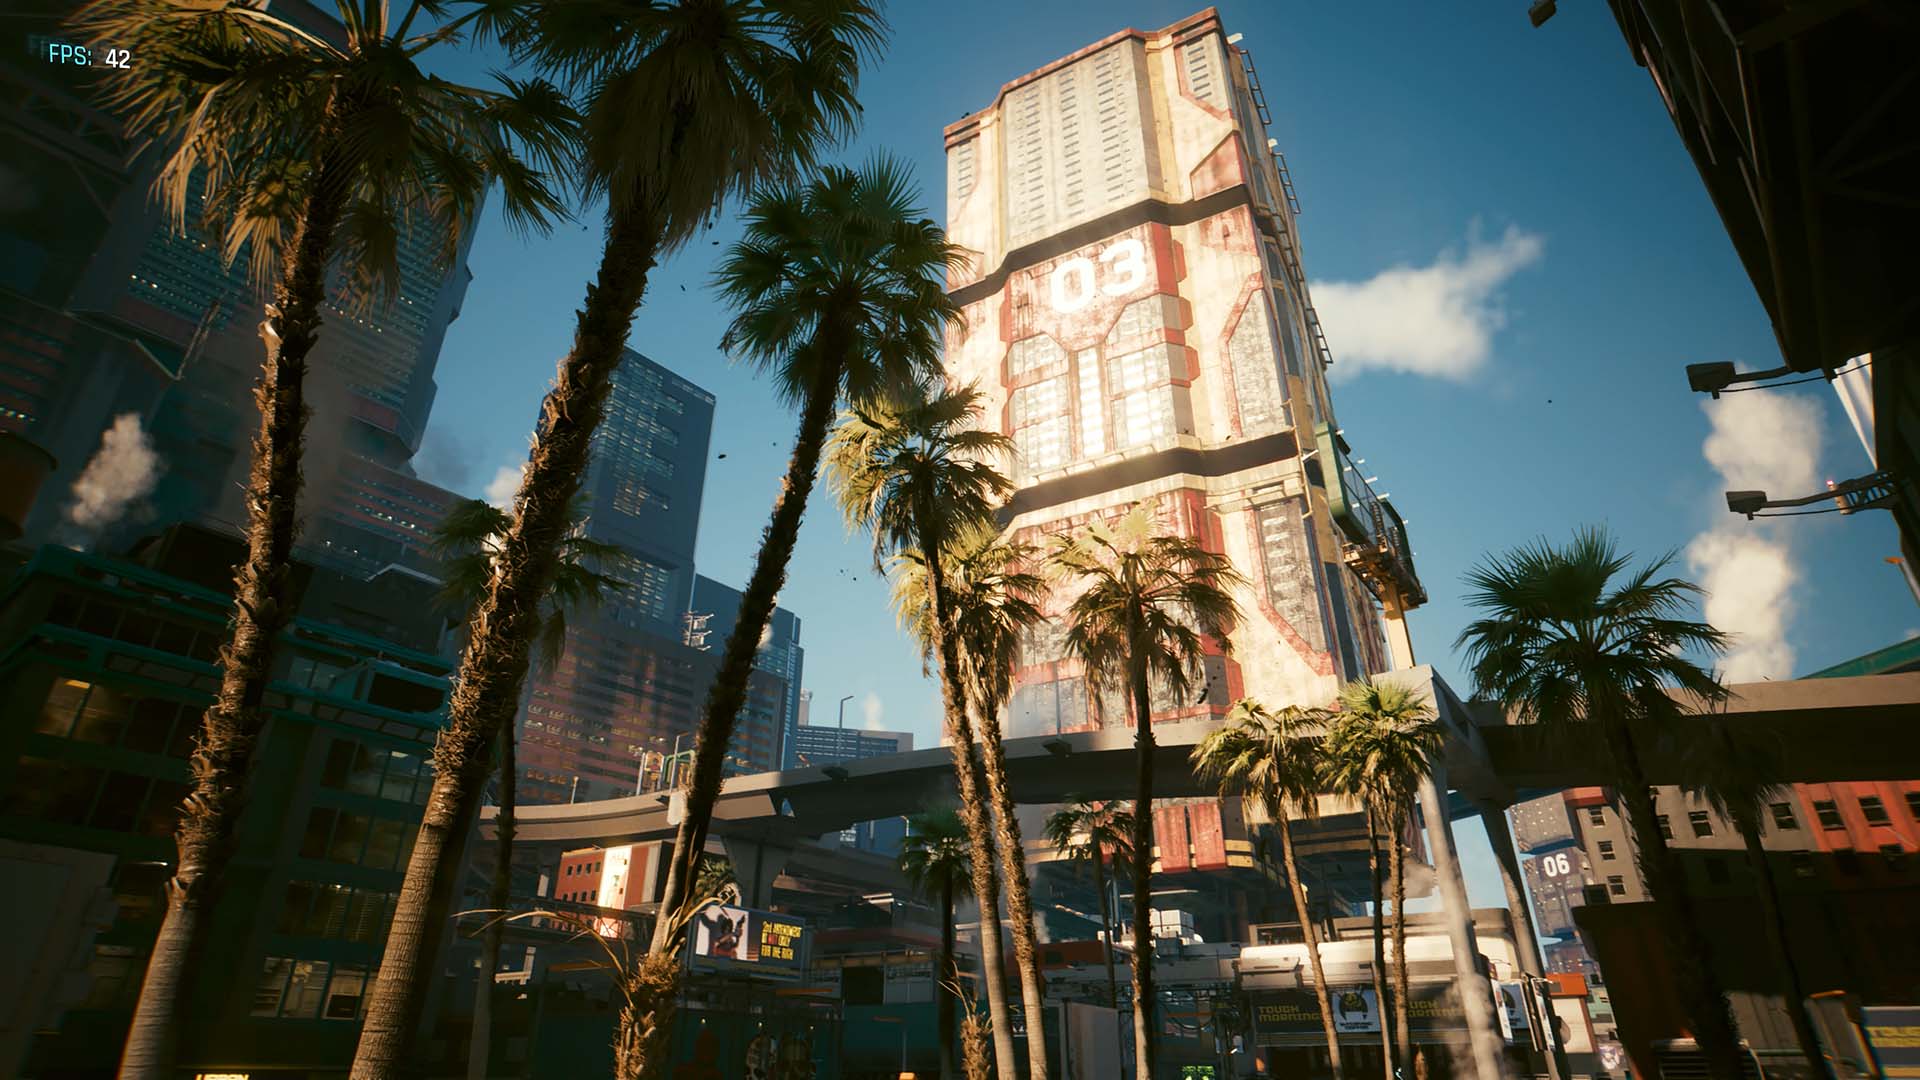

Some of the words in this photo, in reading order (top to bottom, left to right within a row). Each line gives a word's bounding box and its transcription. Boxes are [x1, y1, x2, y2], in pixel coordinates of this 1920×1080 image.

[1050, 238, 1147, 314] 03
[1543, 852, 1570, 878] 06
[1257, 1004, 1299, 1014] TOUGH
